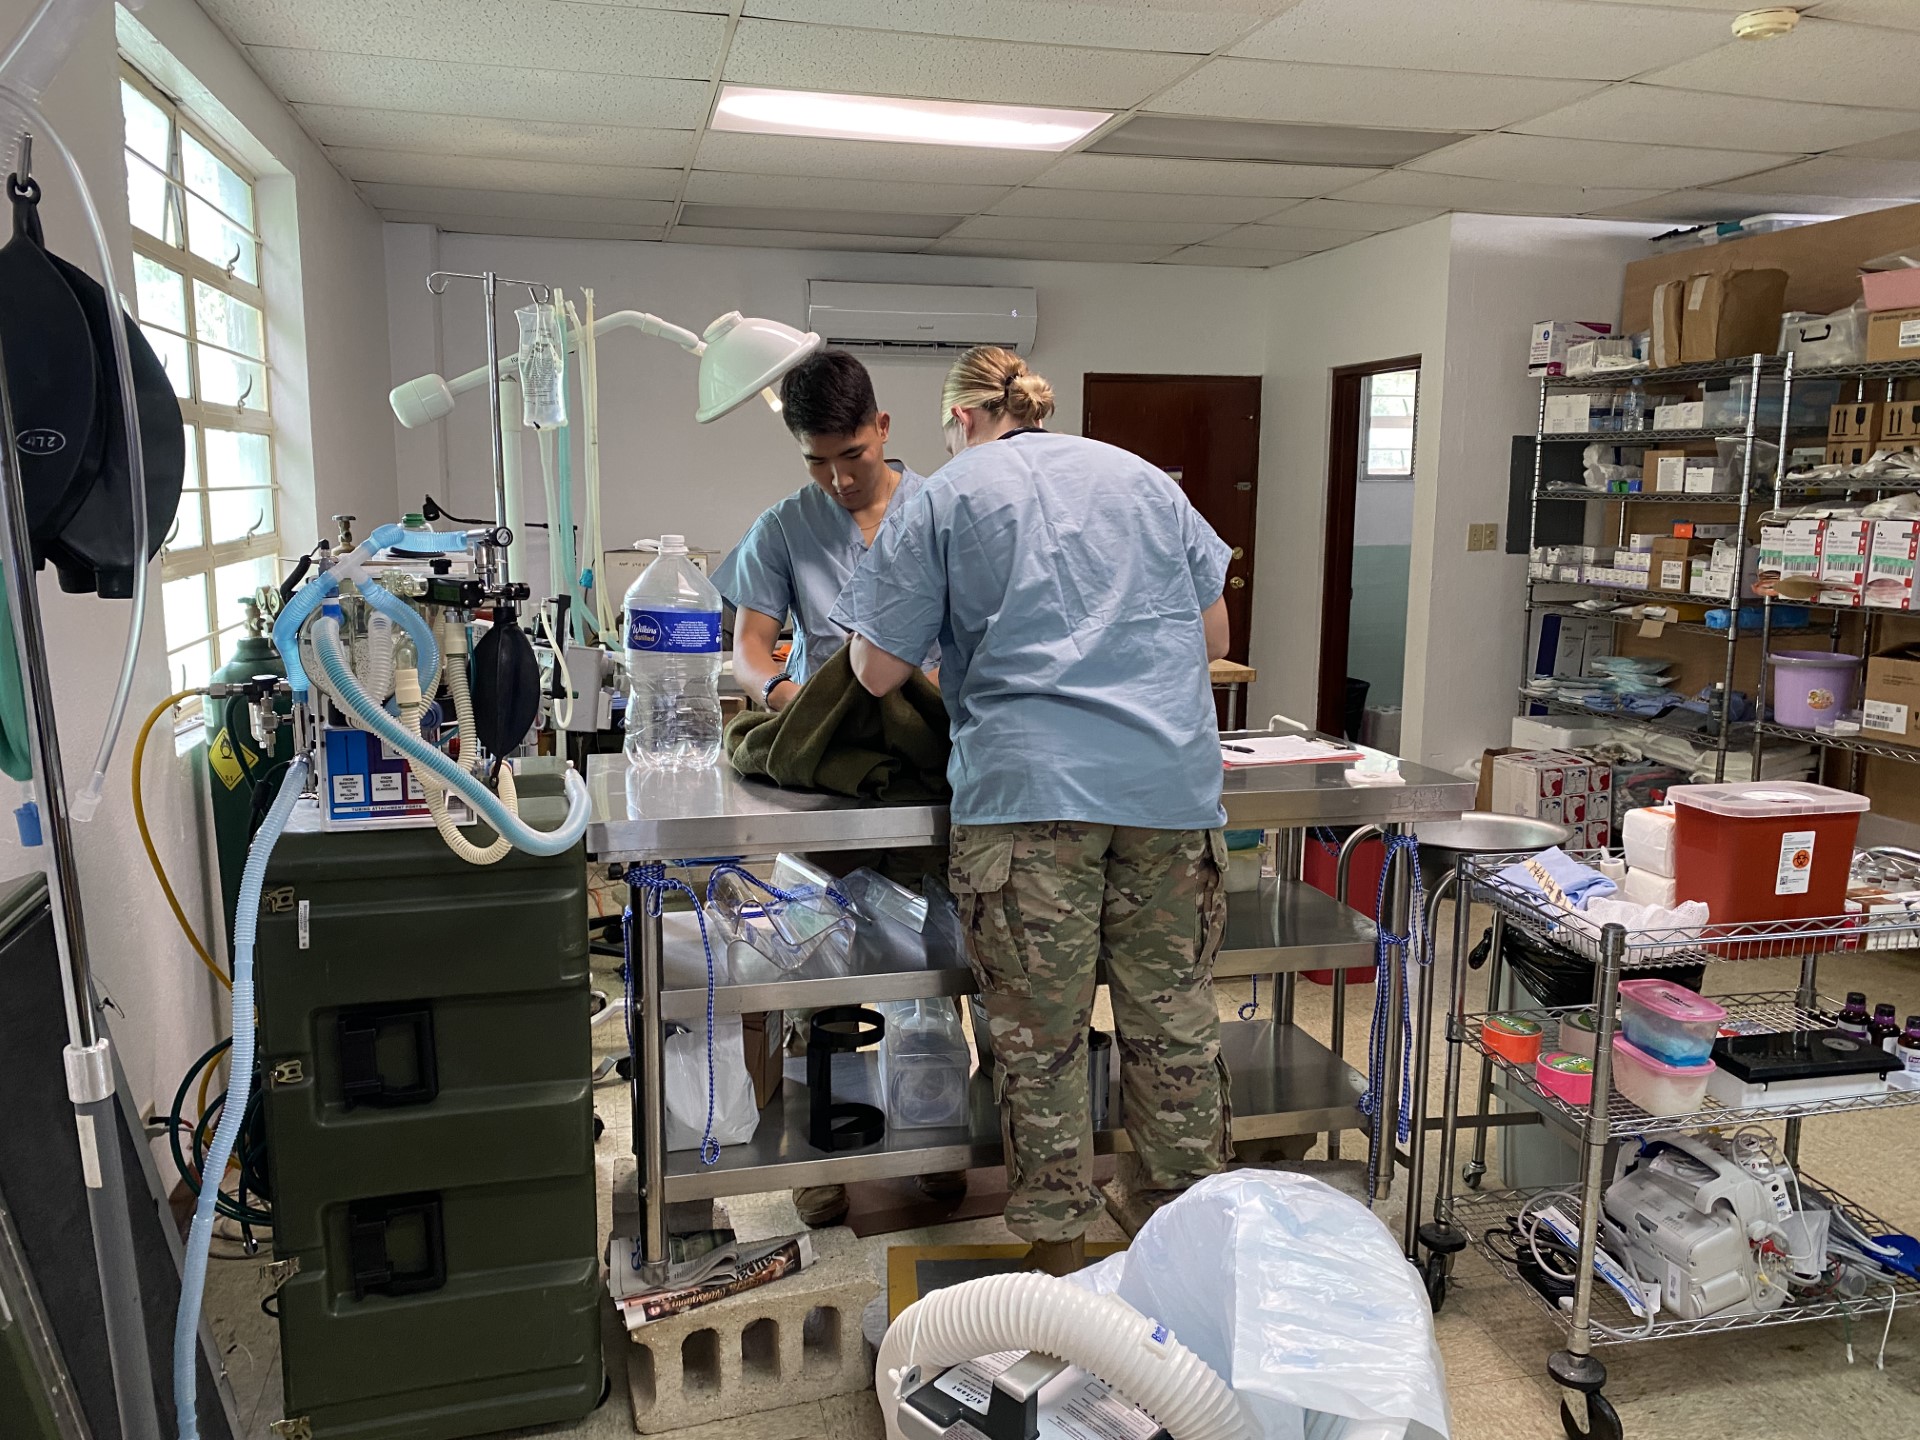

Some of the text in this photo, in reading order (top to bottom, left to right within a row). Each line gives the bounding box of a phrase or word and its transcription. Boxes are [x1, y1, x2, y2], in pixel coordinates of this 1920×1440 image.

[47, 436, 55, 447] 2
[631, 623, 657, 634] Wilkins
[951, 1385, 984, 1405] Arizant
